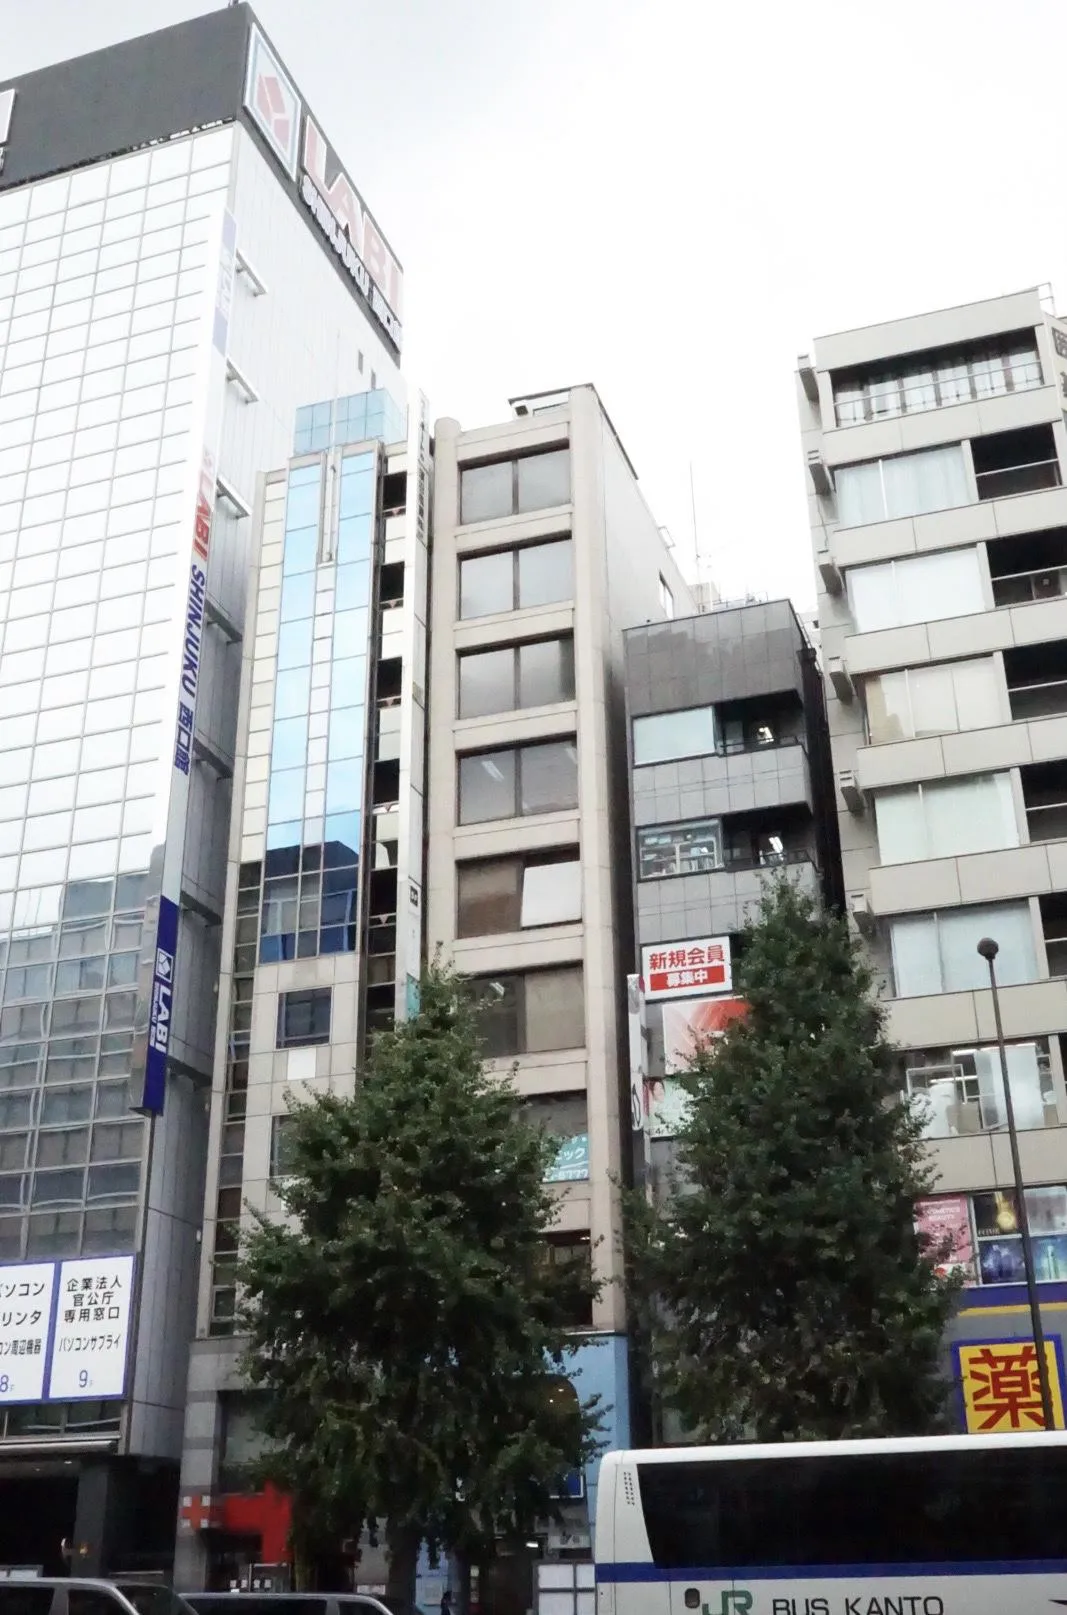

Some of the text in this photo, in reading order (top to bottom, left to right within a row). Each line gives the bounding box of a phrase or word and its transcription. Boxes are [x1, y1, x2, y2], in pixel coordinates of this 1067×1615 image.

[303, 114, 402, 326] LABI
[174, 470, 215, 776] LABI SHINJUKU 西口館
[648, 944, 725, 971] 新規会員
[666, 969, 708, 987] 募集中
[156, 985, 171, 1054] LABI
[65, 1274, 123, 1293] 企業法人
[73, 1291, 115, 1308] 官公庁
[0, 1310, 43, 1328] リンタ
[63, 1306, 121, 1324] 専用窓口
[58, 1333, 122, 1354] パソコンサプライ
[968, 1346, 1049, 1431] 薬
[701, 1589, 754, 1615] JR
[772, 1595, 945, 1615] BUS KANTO
